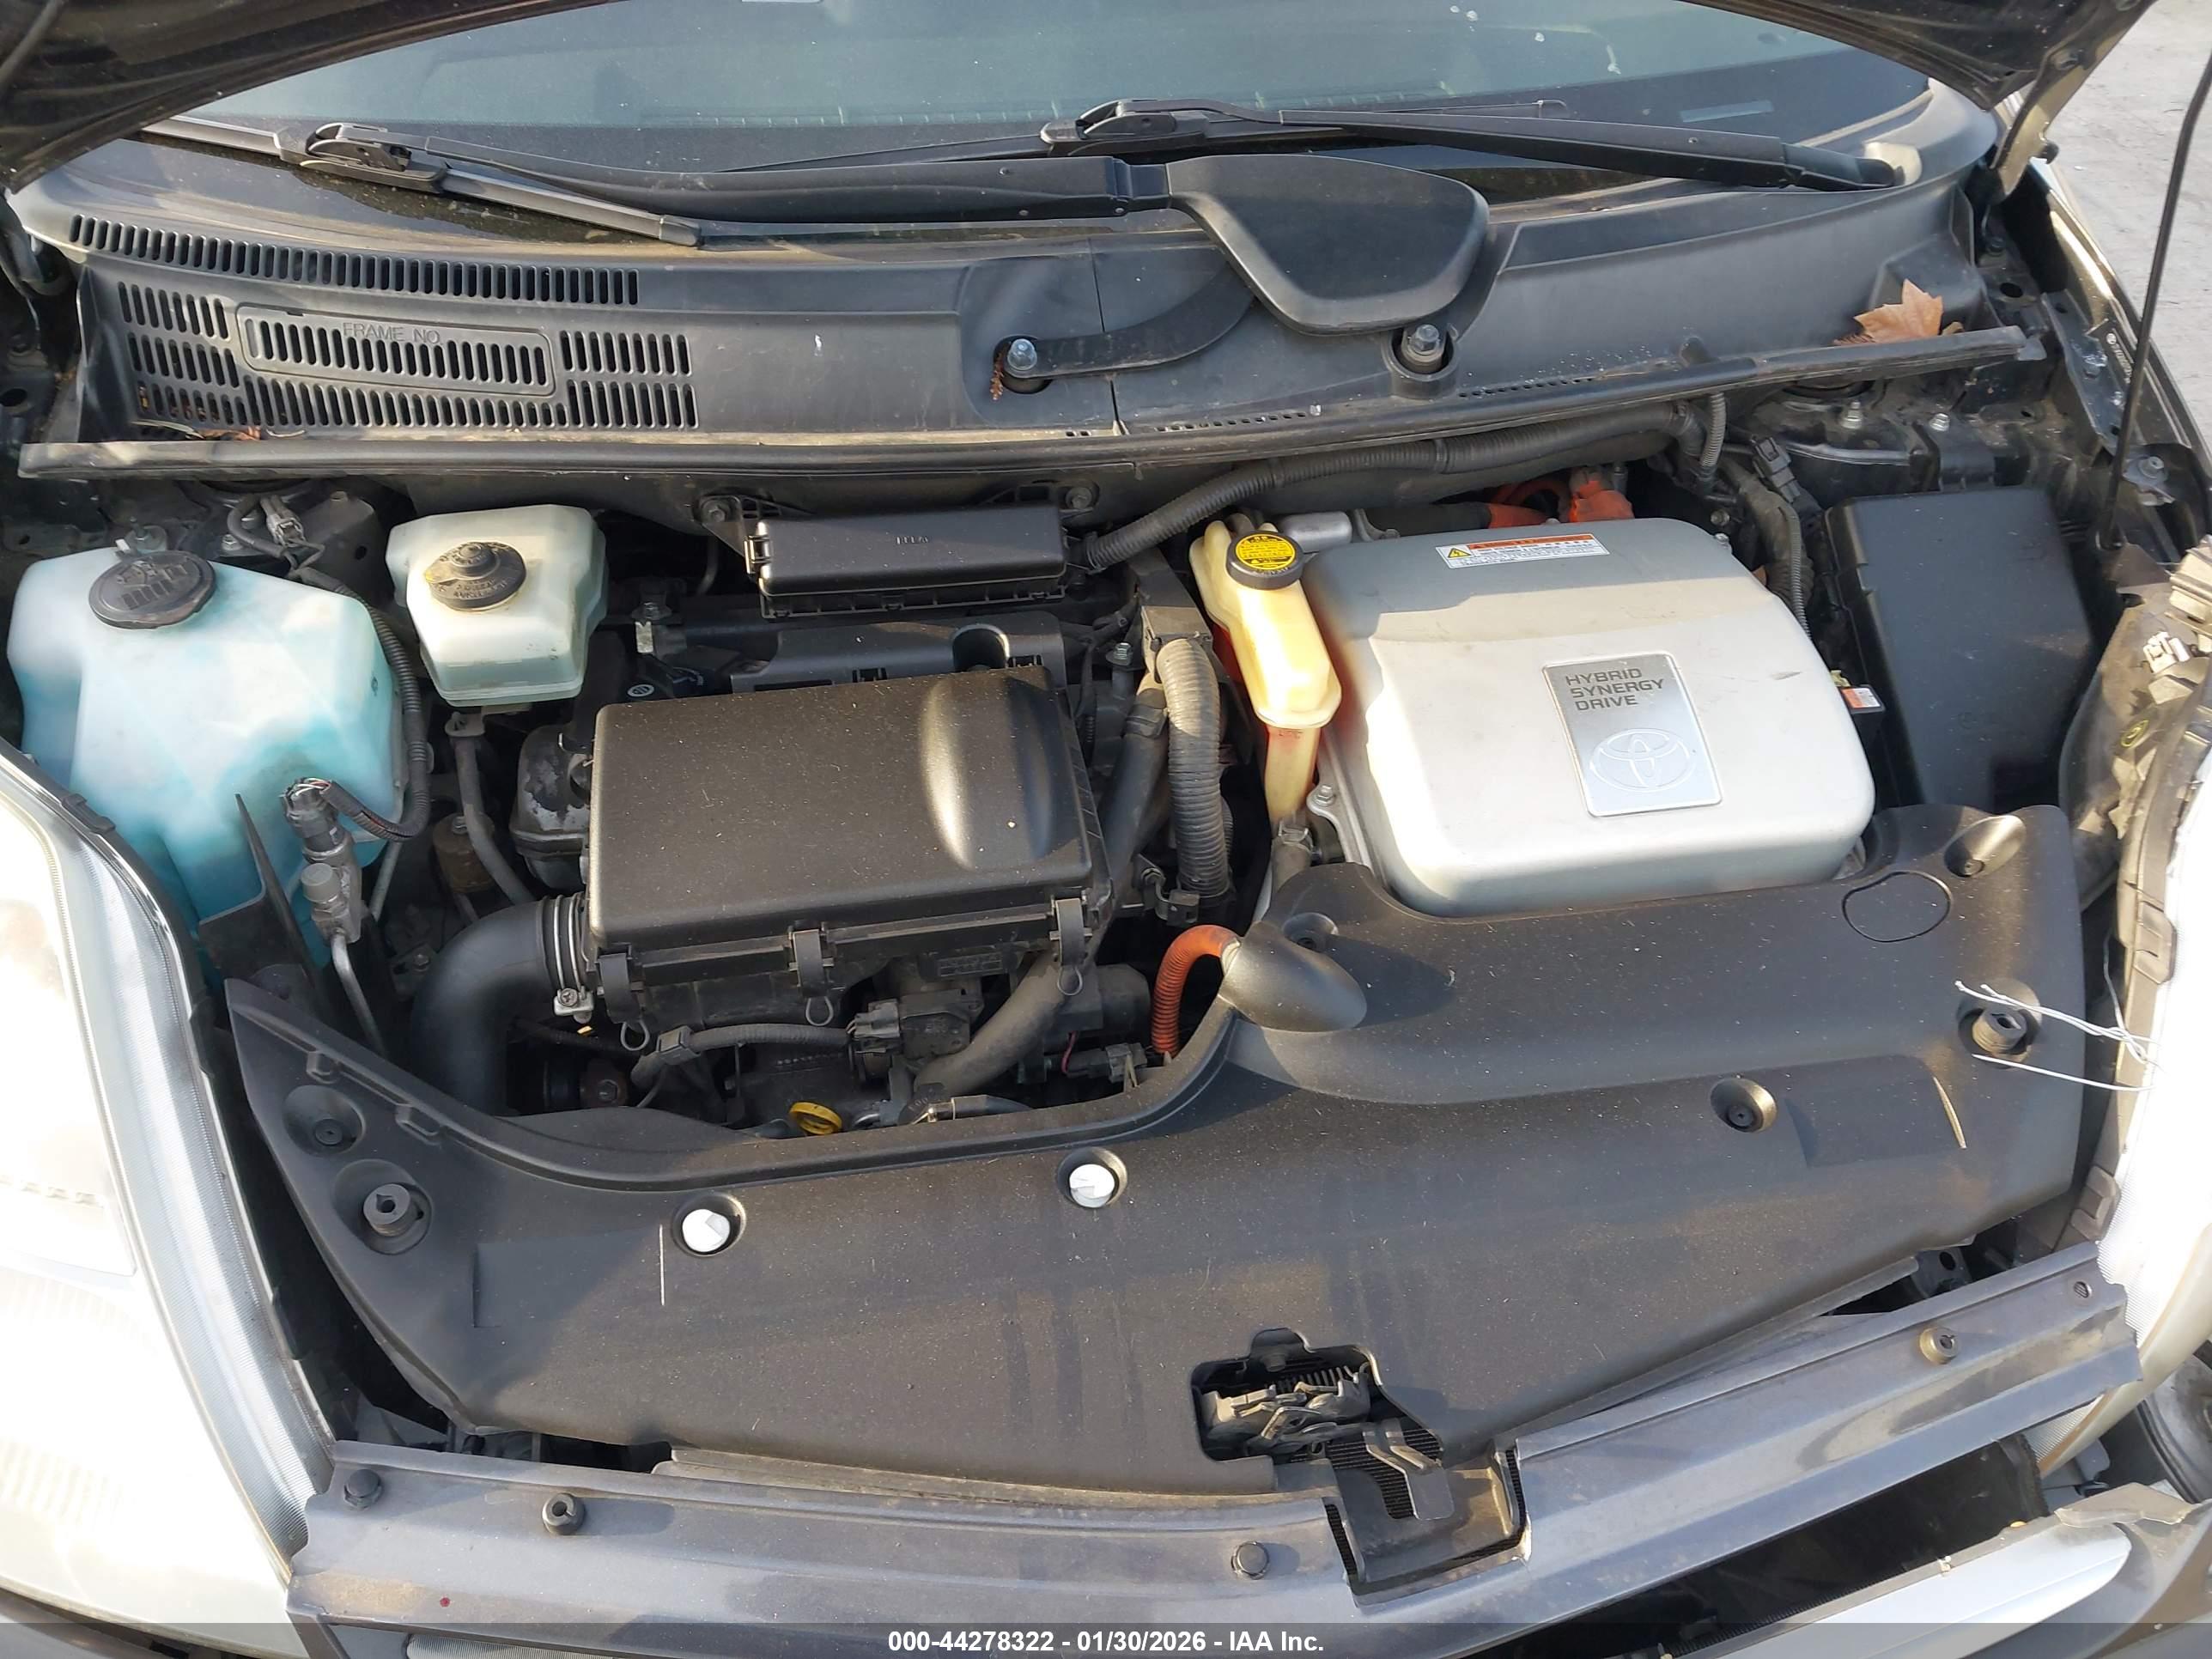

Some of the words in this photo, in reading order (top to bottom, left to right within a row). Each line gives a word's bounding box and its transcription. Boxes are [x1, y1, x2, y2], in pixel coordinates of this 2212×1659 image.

[343, 322, 405, 342] FRAME
[413, 328, 444, 345] NO.
[1565, 668, 1643, 686] HYBRID
[1571, 678, 1664, 698] SYNERGY
[1574, 695, 1639, 711] DRIVE
